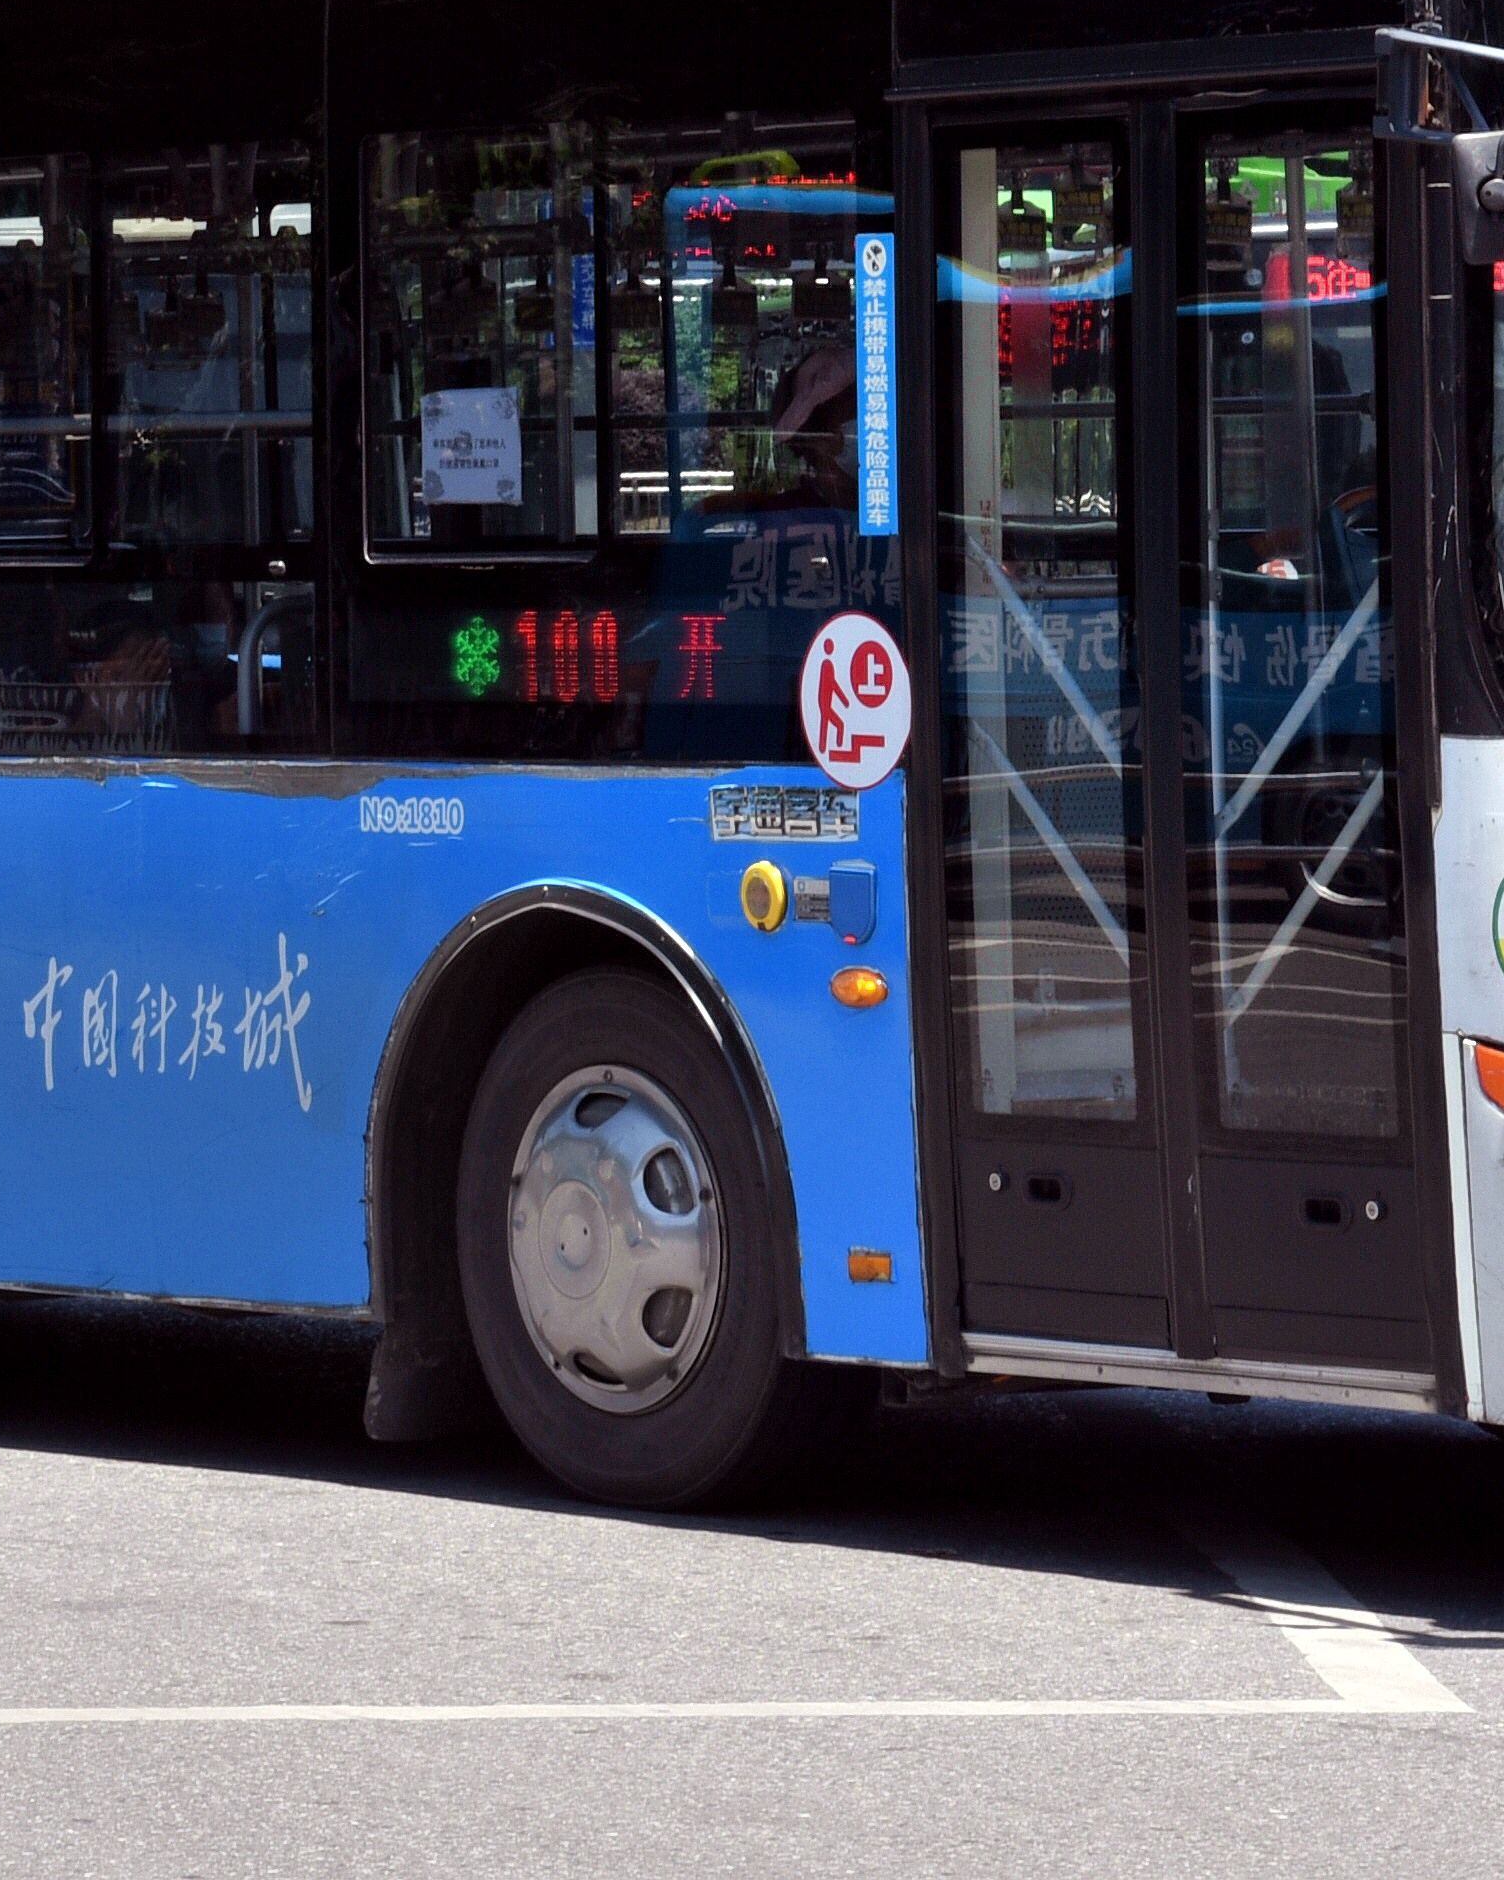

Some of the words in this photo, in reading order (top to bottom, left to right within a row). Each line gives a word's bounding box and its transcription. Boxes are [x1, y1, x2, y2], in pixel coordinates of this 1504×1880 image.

[863, 278, 891, 528] 禁止携带易燃易爆危险品乘车
[516, 610, 621, 704] 100
[678, 614, 728, 701] 开
[858, 654, 892, 704] 上
[360, 796, 465, 834] NO:1810
